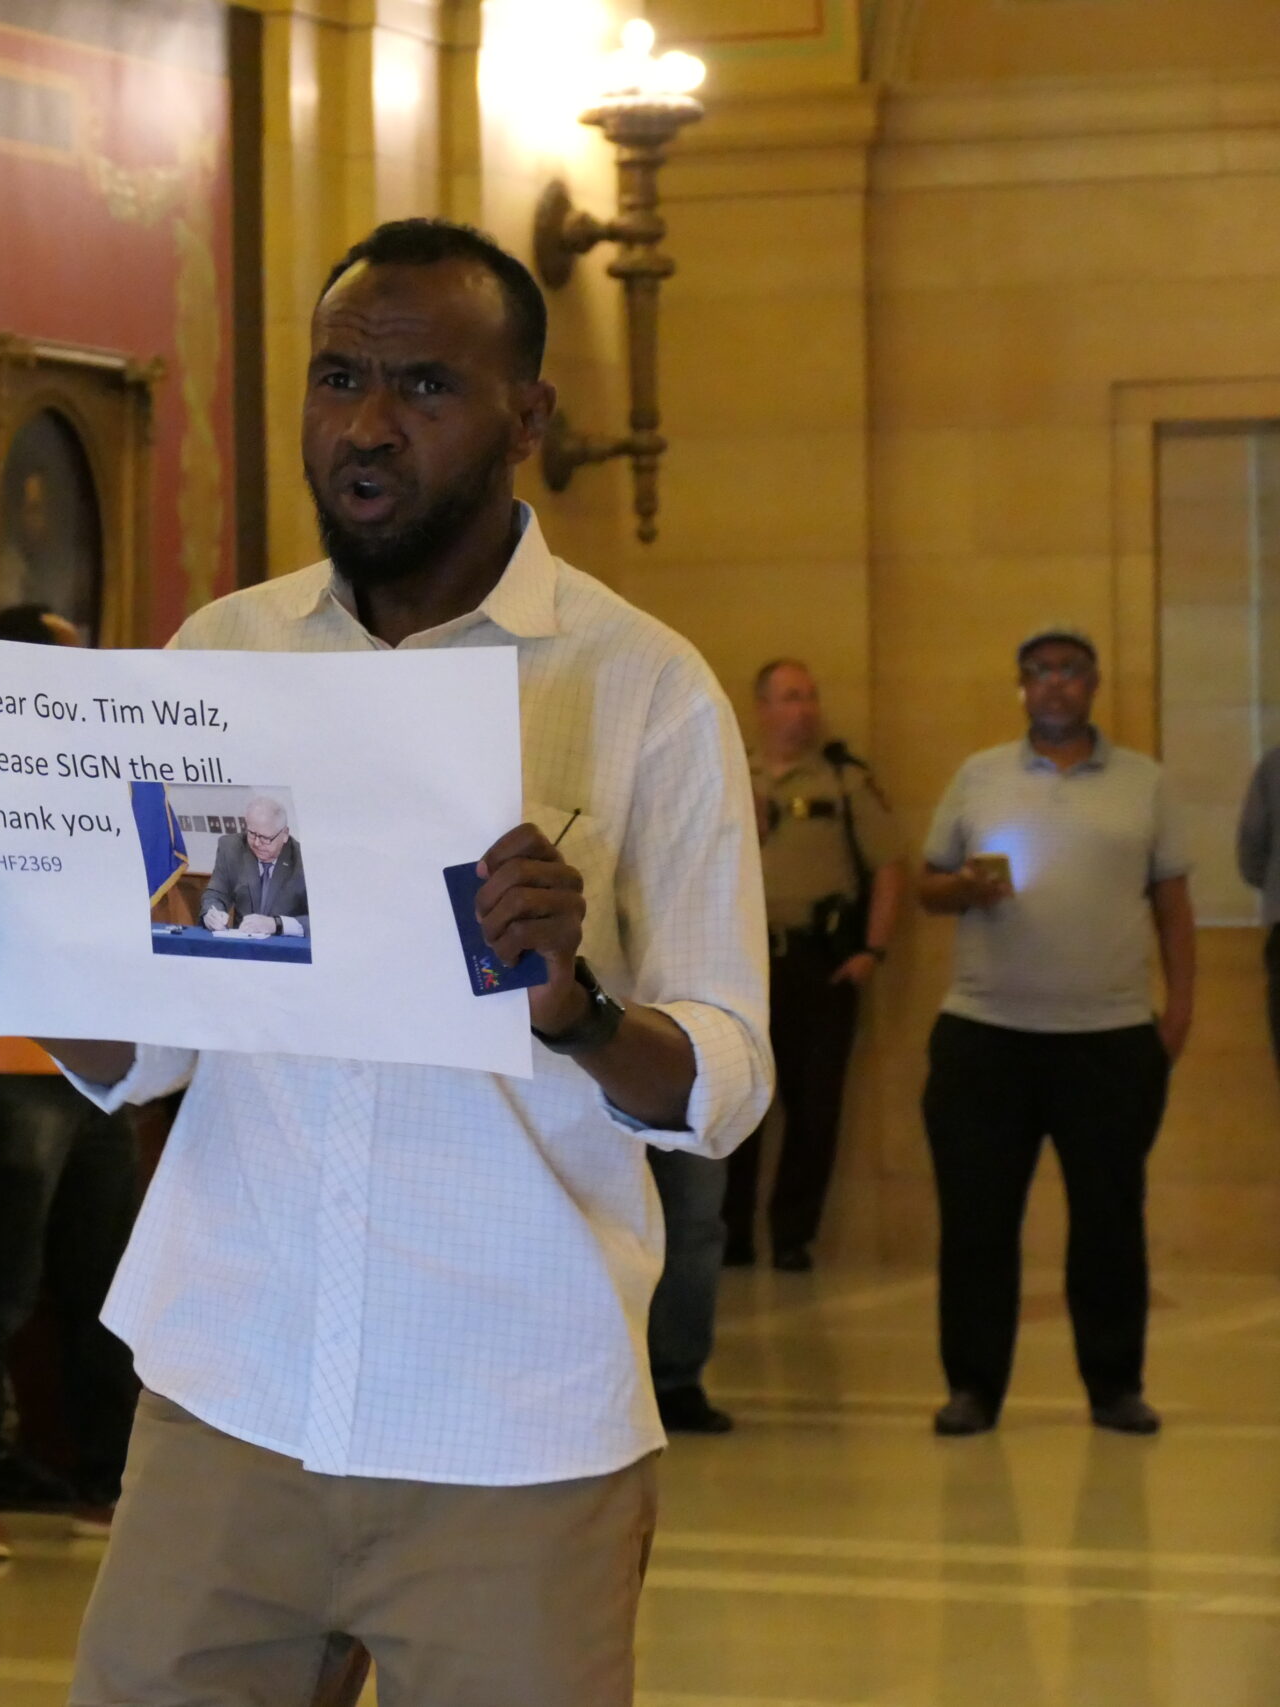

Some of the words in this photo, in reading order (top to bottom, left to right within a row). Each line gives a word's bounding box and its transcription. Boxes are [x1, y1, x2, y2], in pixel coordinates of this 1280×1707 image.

[34, 693, 86, 722] Gov.
[93, 698, 144, 724] Tim
[152, 699, 229, 732] Walz,
[56, 753, 122, 779] SIGN
[128, 755, 174, 781] the
[182, 756, 232, 783] bill.
[62, 813, 121, 837] you,
